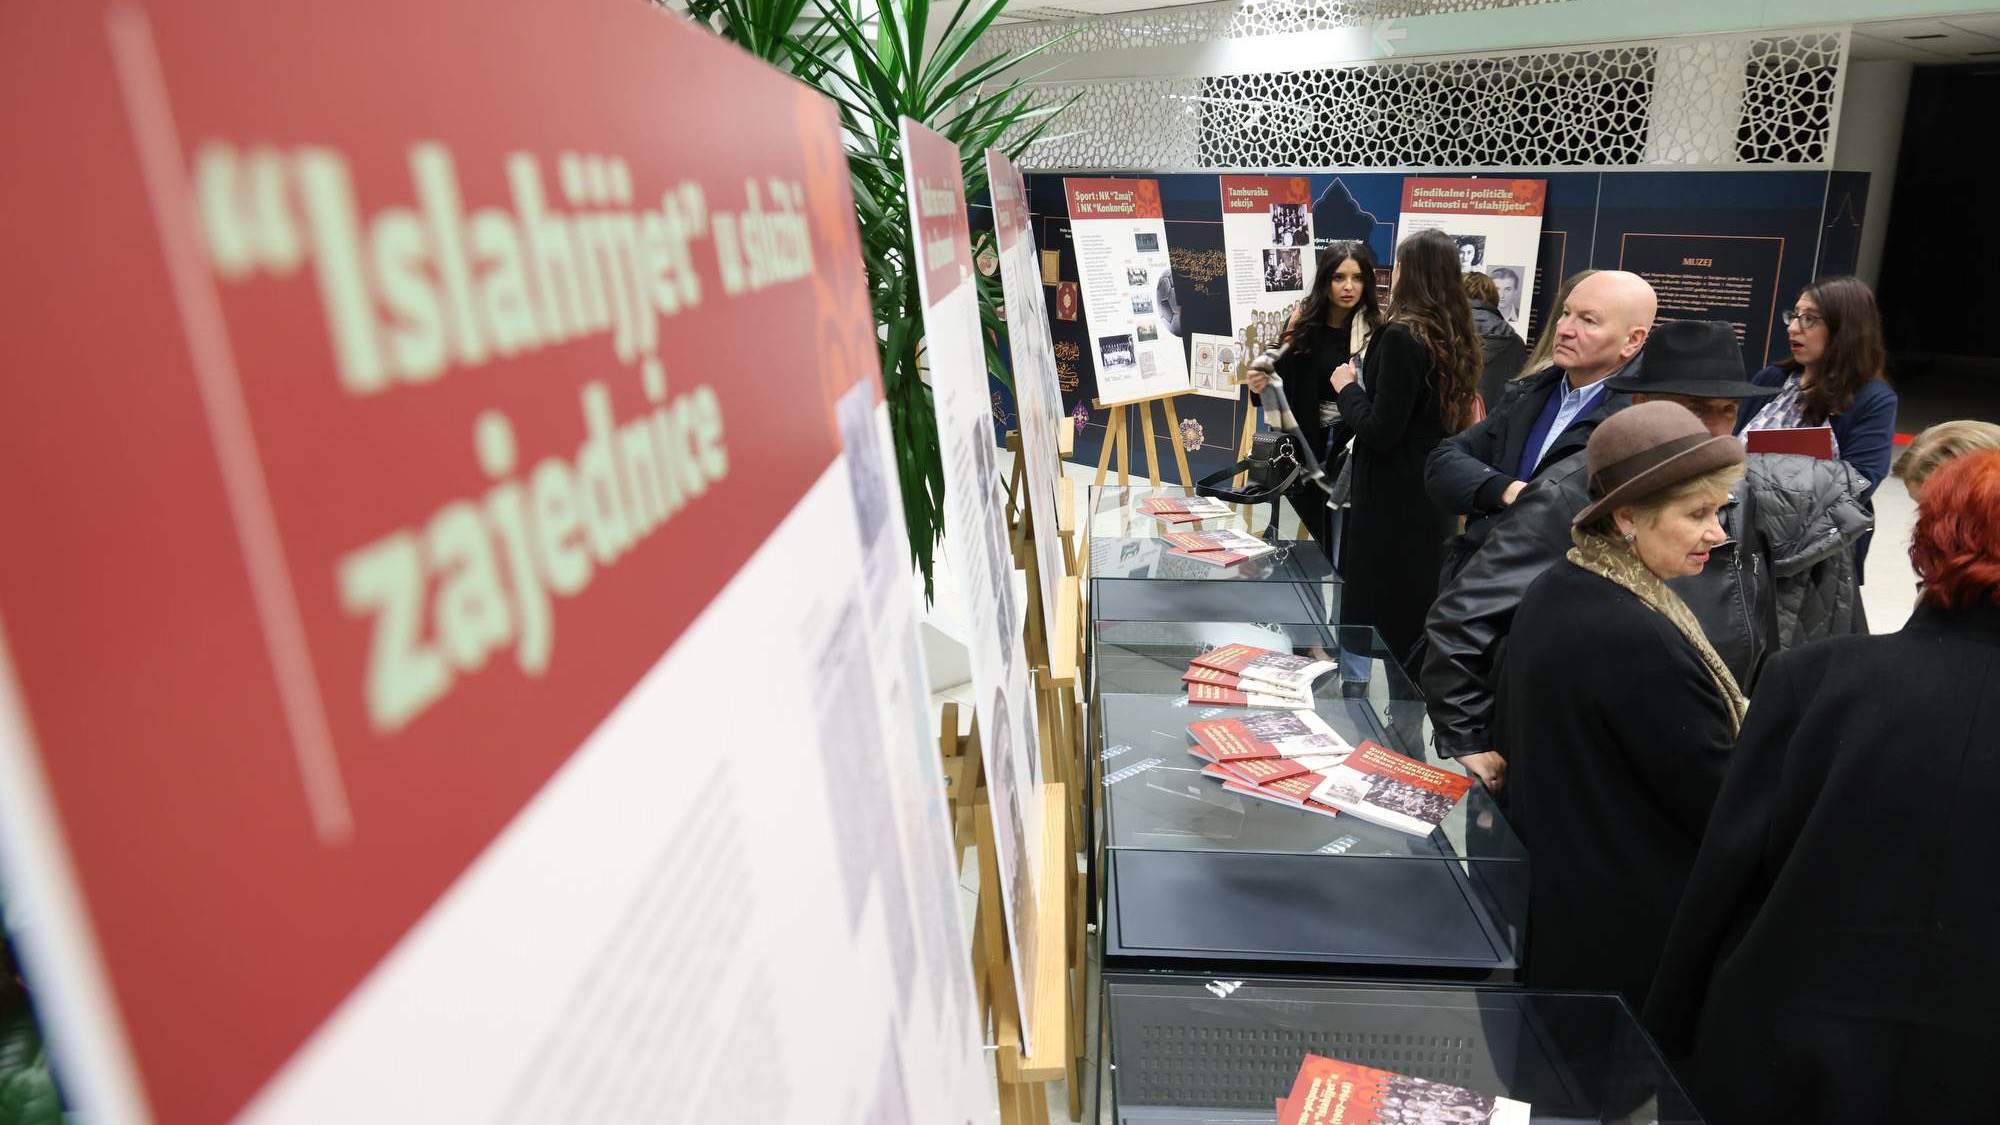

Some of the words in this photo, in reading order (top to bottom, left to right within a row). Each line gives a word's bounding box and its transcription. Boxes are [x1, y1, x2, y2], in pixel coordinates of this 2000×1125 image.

[1099, 191, 1110, 201] NK
[1229, 187, 1269, 197] Tamburaška
[1413, 187, 1465, 198] Sindikalne
[1466, 188, 1470, 198] i
[1470, 189, 1513, 200] političke
[1081, 203, 1093, 213] NK
[1230, 198, 1254, 209] sekcija
[1412, 199, 1461, 209] aktivnosti
[1682, 258, 1713, 268] MUZEJ
[336, 357, 731, 734] zajednice
